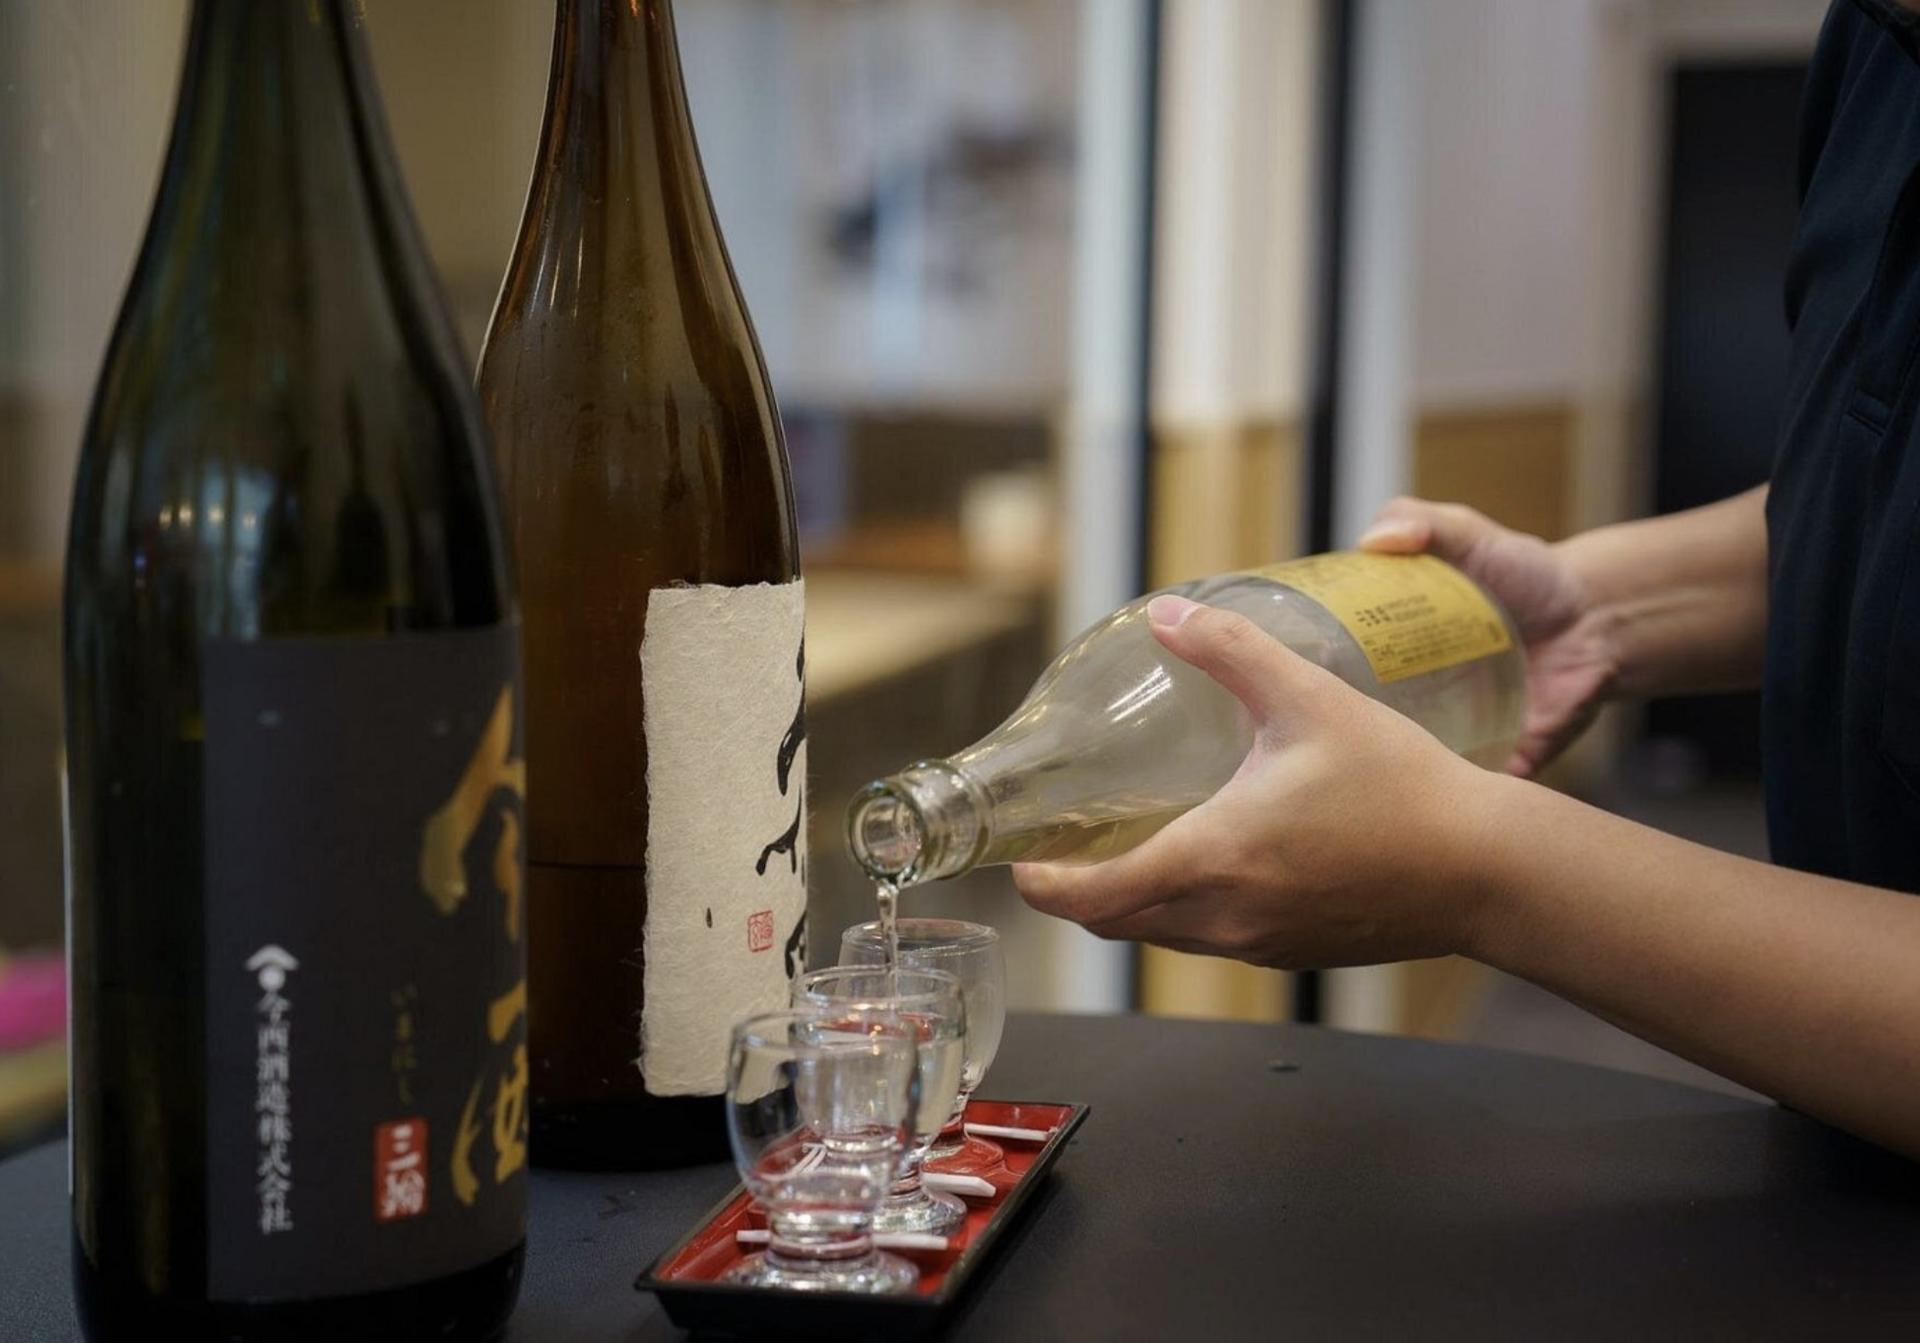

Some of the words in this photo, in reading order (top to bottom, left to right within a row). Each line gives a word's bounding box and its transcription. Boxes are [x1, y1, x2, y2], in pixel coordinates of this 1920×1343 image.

[256, 992, 293, 1234] 今西酒造株式会社
